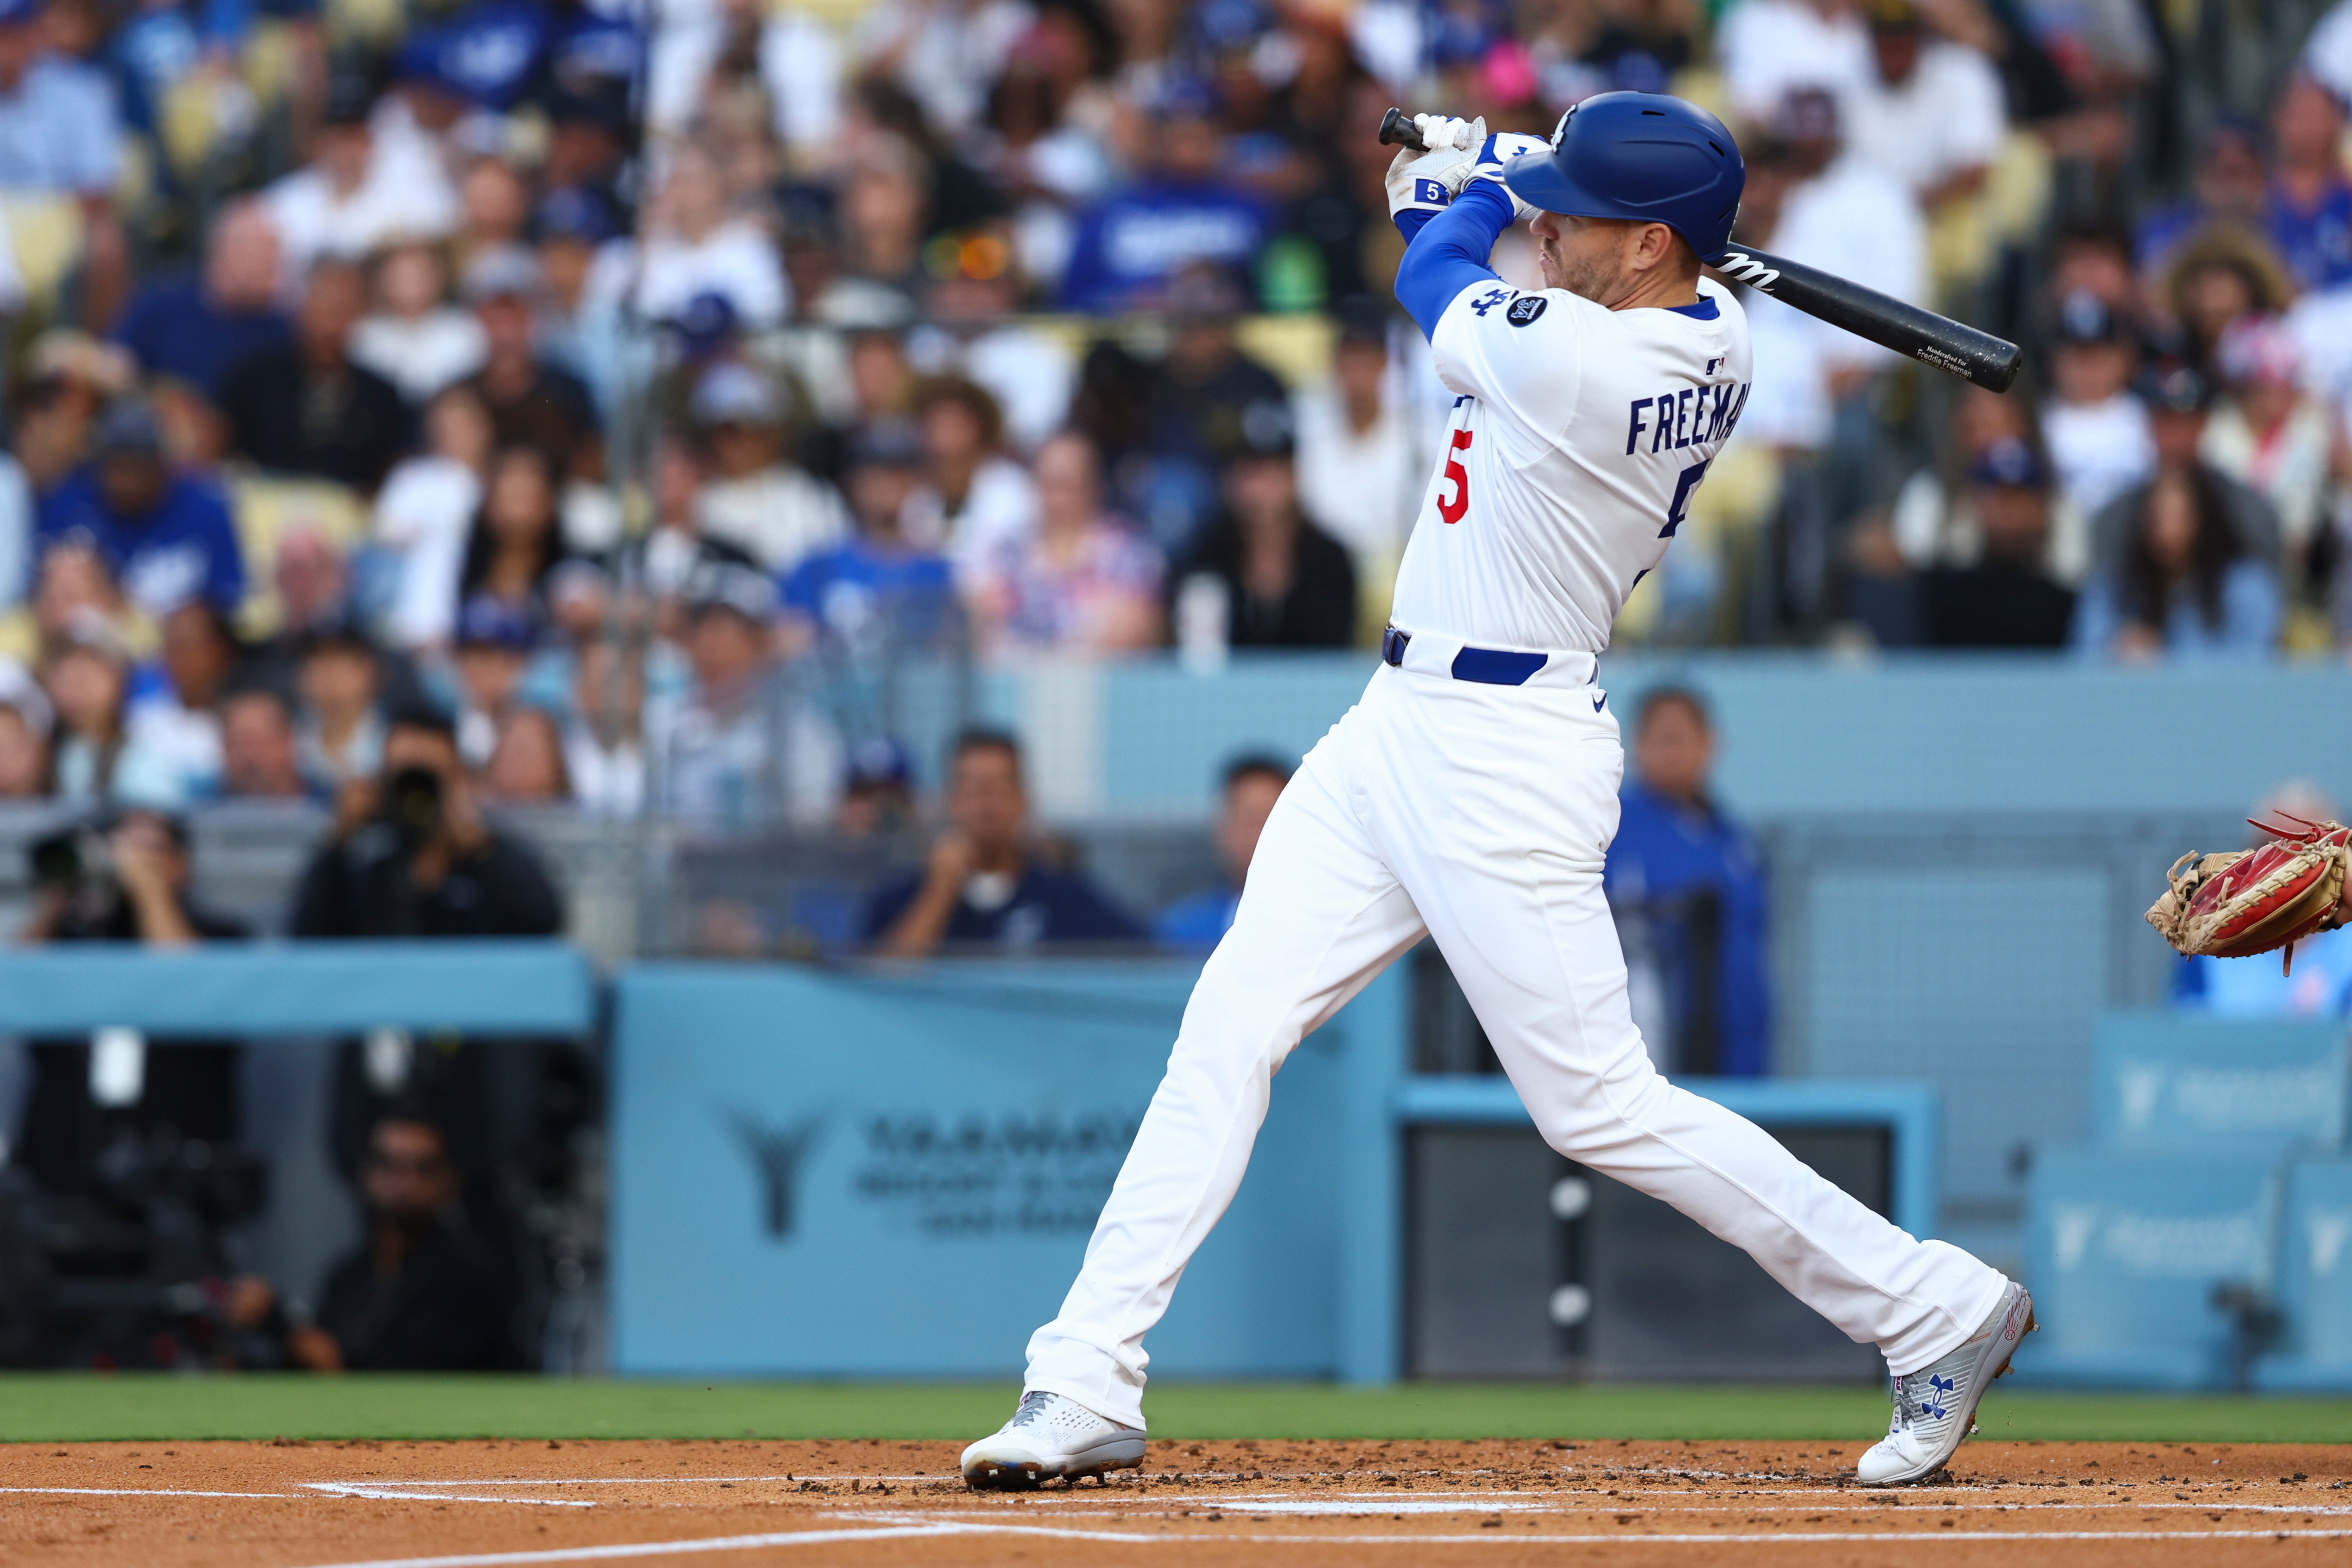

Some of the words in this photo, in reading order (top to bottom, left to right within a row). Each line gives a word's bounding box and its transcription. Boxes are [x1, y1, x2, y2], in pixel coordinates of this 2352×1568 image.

[1426, 182, 1439, 201] 5
[1510, 299, 1535, 319] 34
[1917, 348, 1942, 365] Freddie
[1942, 359, 1972, 378] Freeman
[1927, 345, 1958, 362] Handcrafted
[1958, 358, 1967, 366] For
[1626, 382, 1751, 456] FREEMA
[1437, 429, 1473, 524] 5
